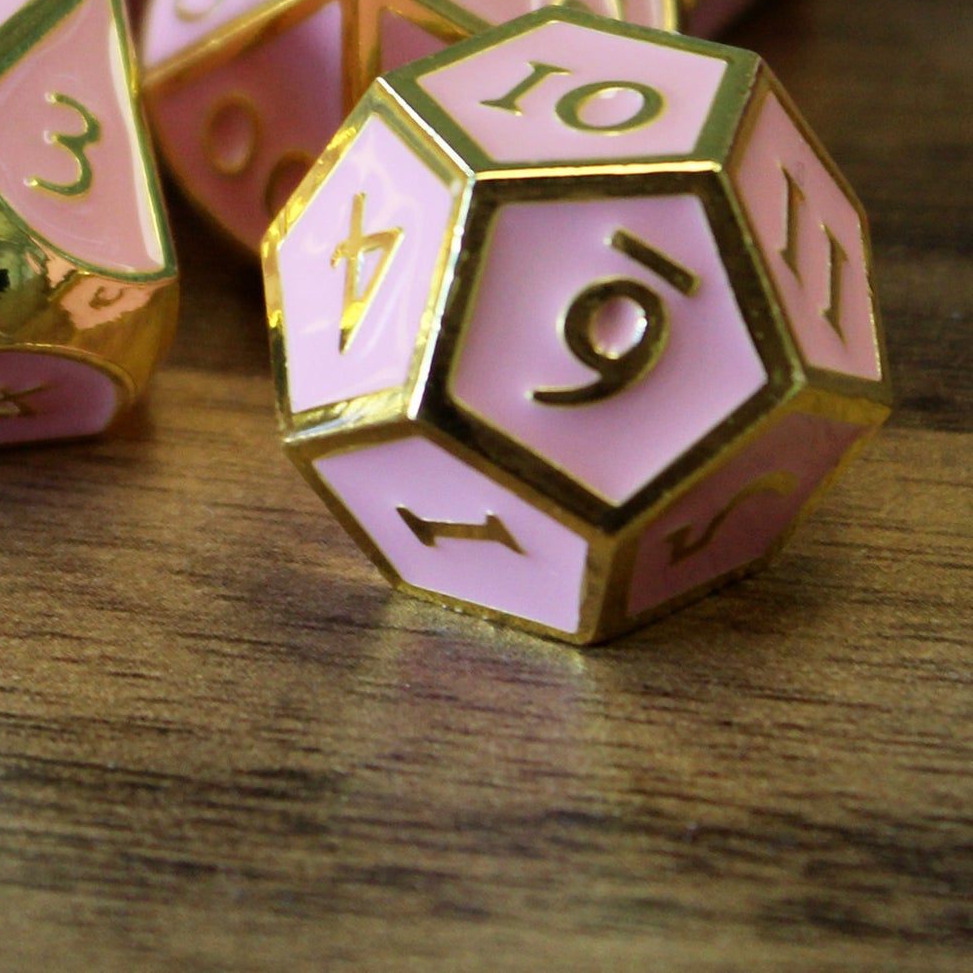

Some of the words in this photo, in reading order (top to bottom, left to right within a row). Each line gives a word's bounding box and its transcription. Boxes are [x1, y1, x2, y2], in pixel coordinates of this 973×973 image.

[24, 91, 101, 198] 3
[480, 60, 667, 136] 10
[330, 191, 406, 356] 4
[777, 159, 869, 347] 11
[393, 502, 532, 558] 1
